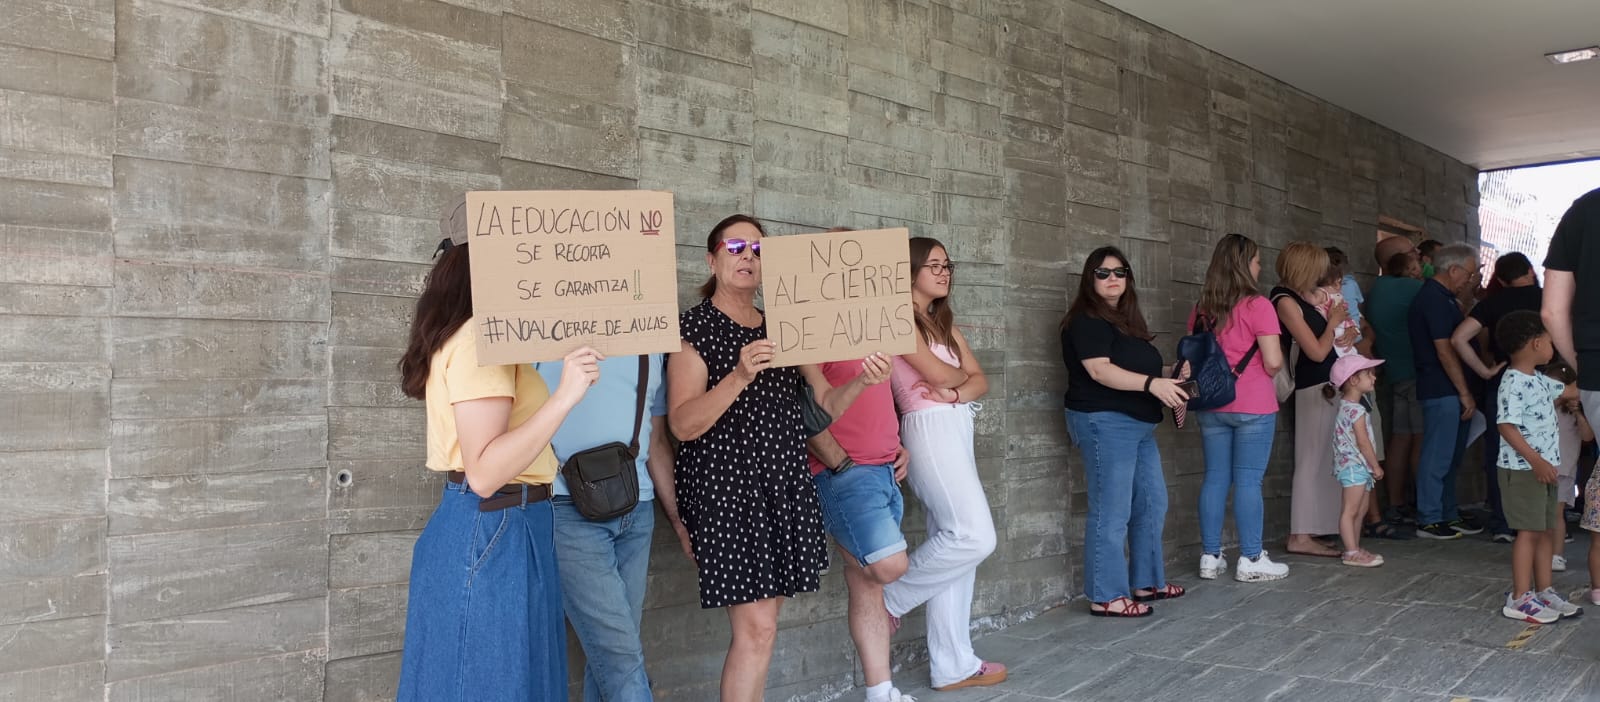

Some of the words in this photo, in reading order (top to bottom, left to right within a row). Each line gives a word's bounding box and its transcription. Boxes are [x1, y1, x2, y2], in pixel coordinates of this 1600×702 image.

[476, 202, 504, 236] LA
[512, 206, 630, 235] EDUCACIÓN
[640, 210, 663, 233] NO
[516, 243, 543, 264] SE
[554, 243, 610, 262] RECORTA
[810, 239, 863, 272] NO
[517, 280, 543, 300] SE
[774, 274, 811, 307] AL
[820, 261, 912, 301] CIERRE
[779, 316, 818, 352] DE
[829, 303, 914, 349] AULAS
